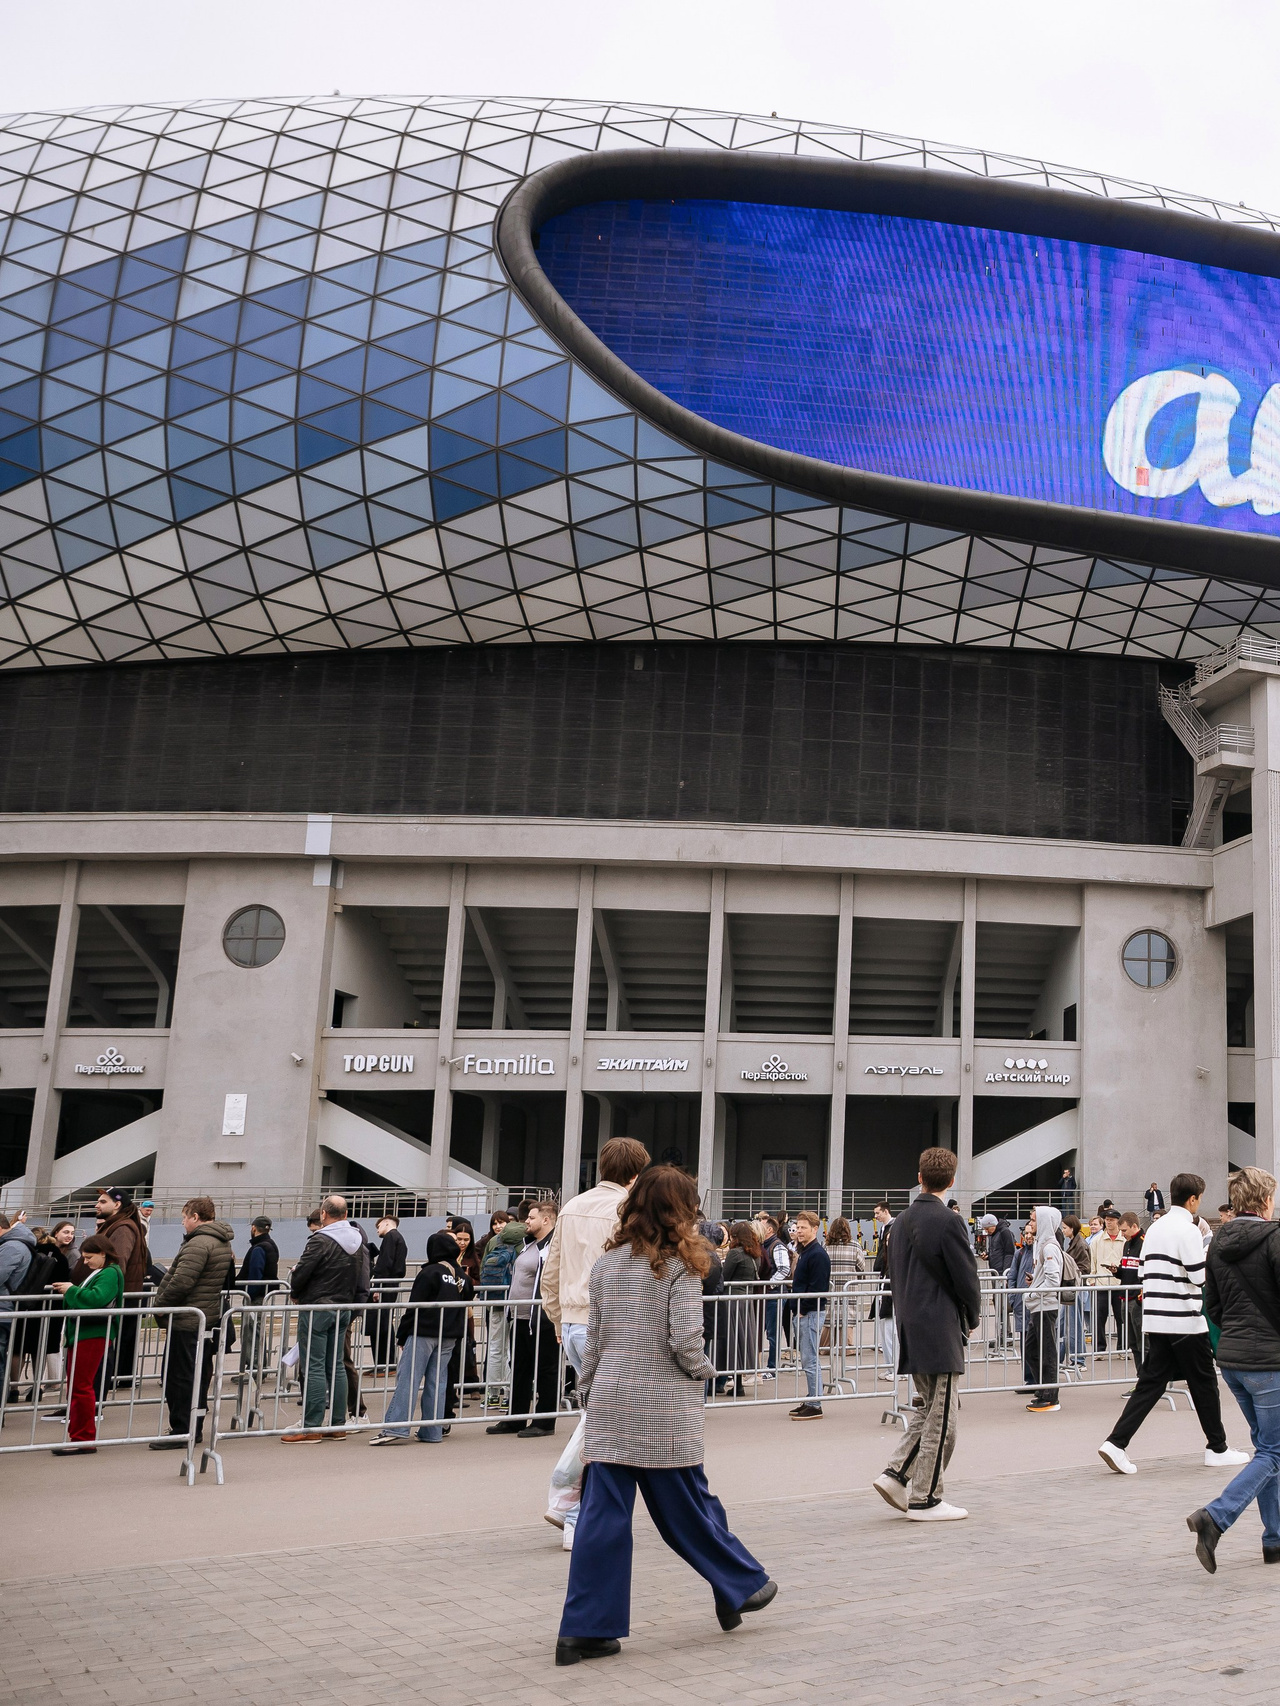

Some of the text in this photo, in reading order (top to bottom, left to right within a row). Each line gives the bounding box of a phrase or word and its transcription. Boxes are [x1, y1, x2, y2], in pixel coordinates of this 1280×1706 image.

[75, 1064, 144, 1075] Перекресток
[597, 1057, 689, 1071] ЭКИПТАЙМ
[741, 1070, 808, 1082] Перекресток
[985, 1070, 1071, 1086] детский мир
